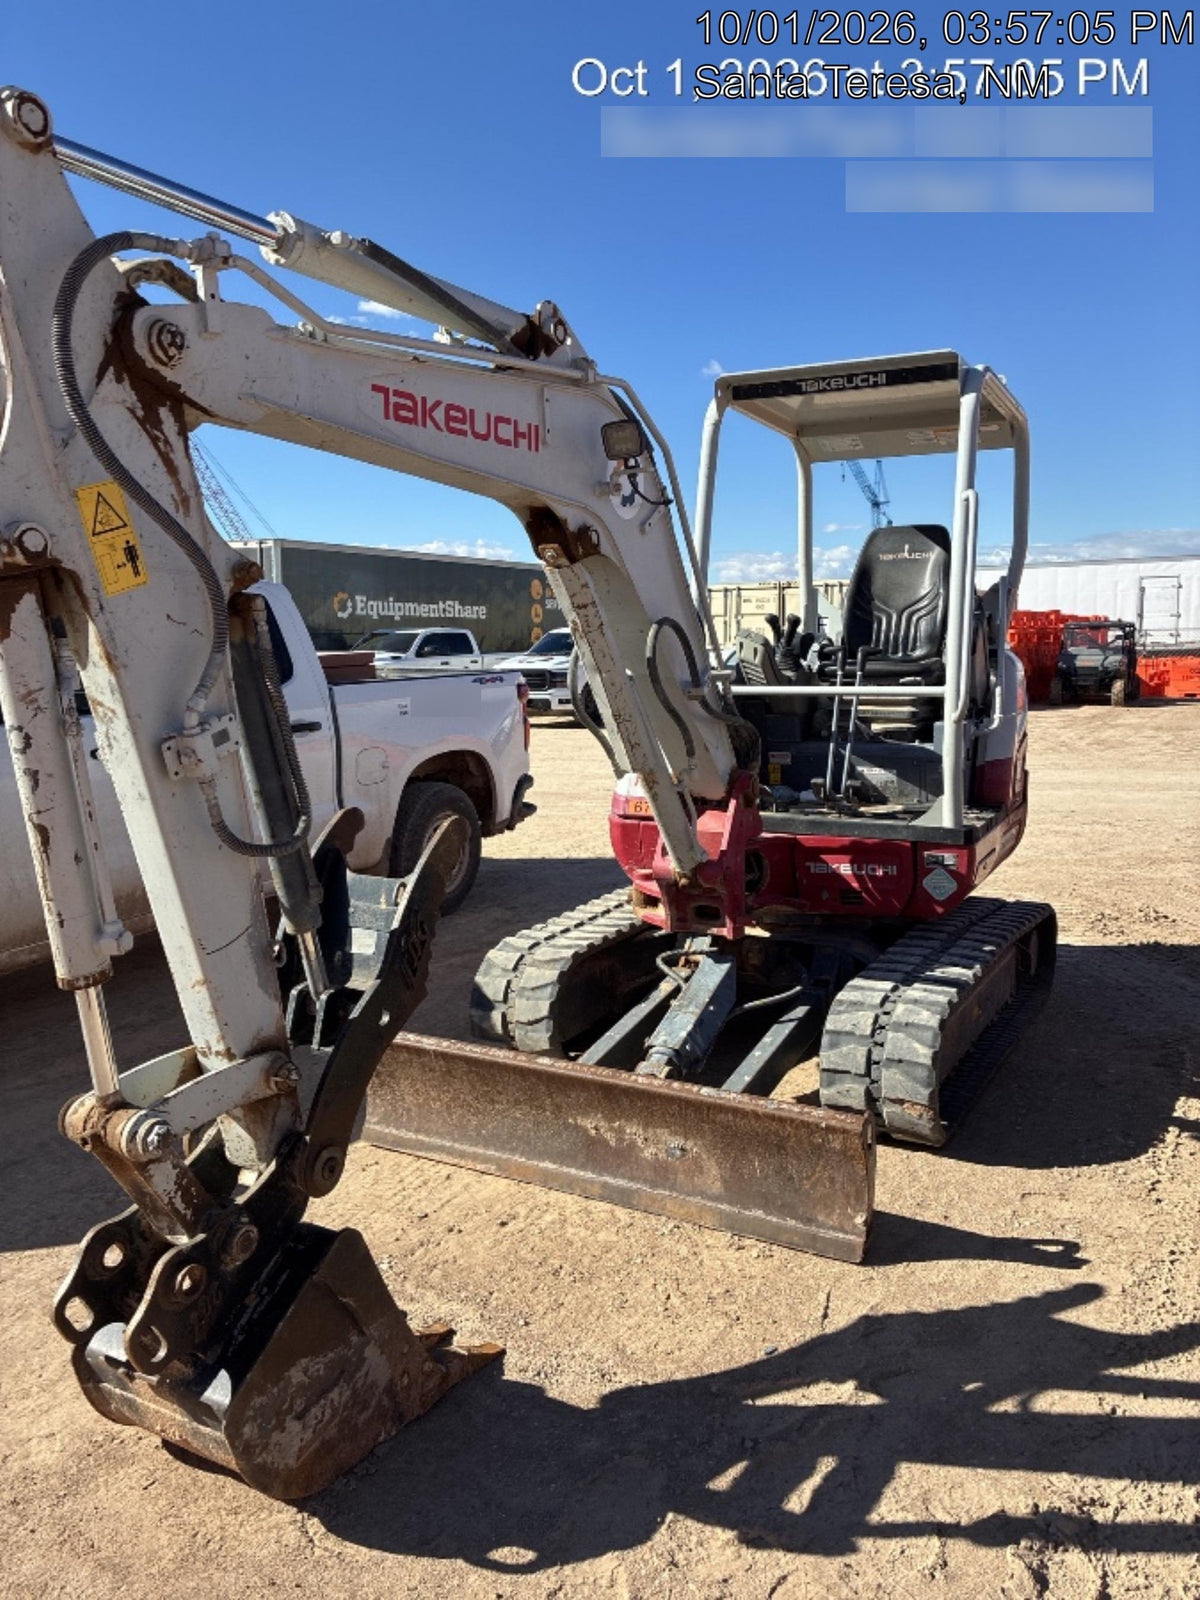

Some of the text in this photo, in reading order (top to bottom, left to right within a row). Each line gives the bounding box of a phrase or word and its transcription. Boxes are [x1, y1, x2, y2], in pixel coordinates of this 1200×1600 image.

[796, 371, 887, 393] TAKEUCHI
[370, 383, 540, 453] TAKEUCHI
[354, 595, 487, 621] EquipmentShare
